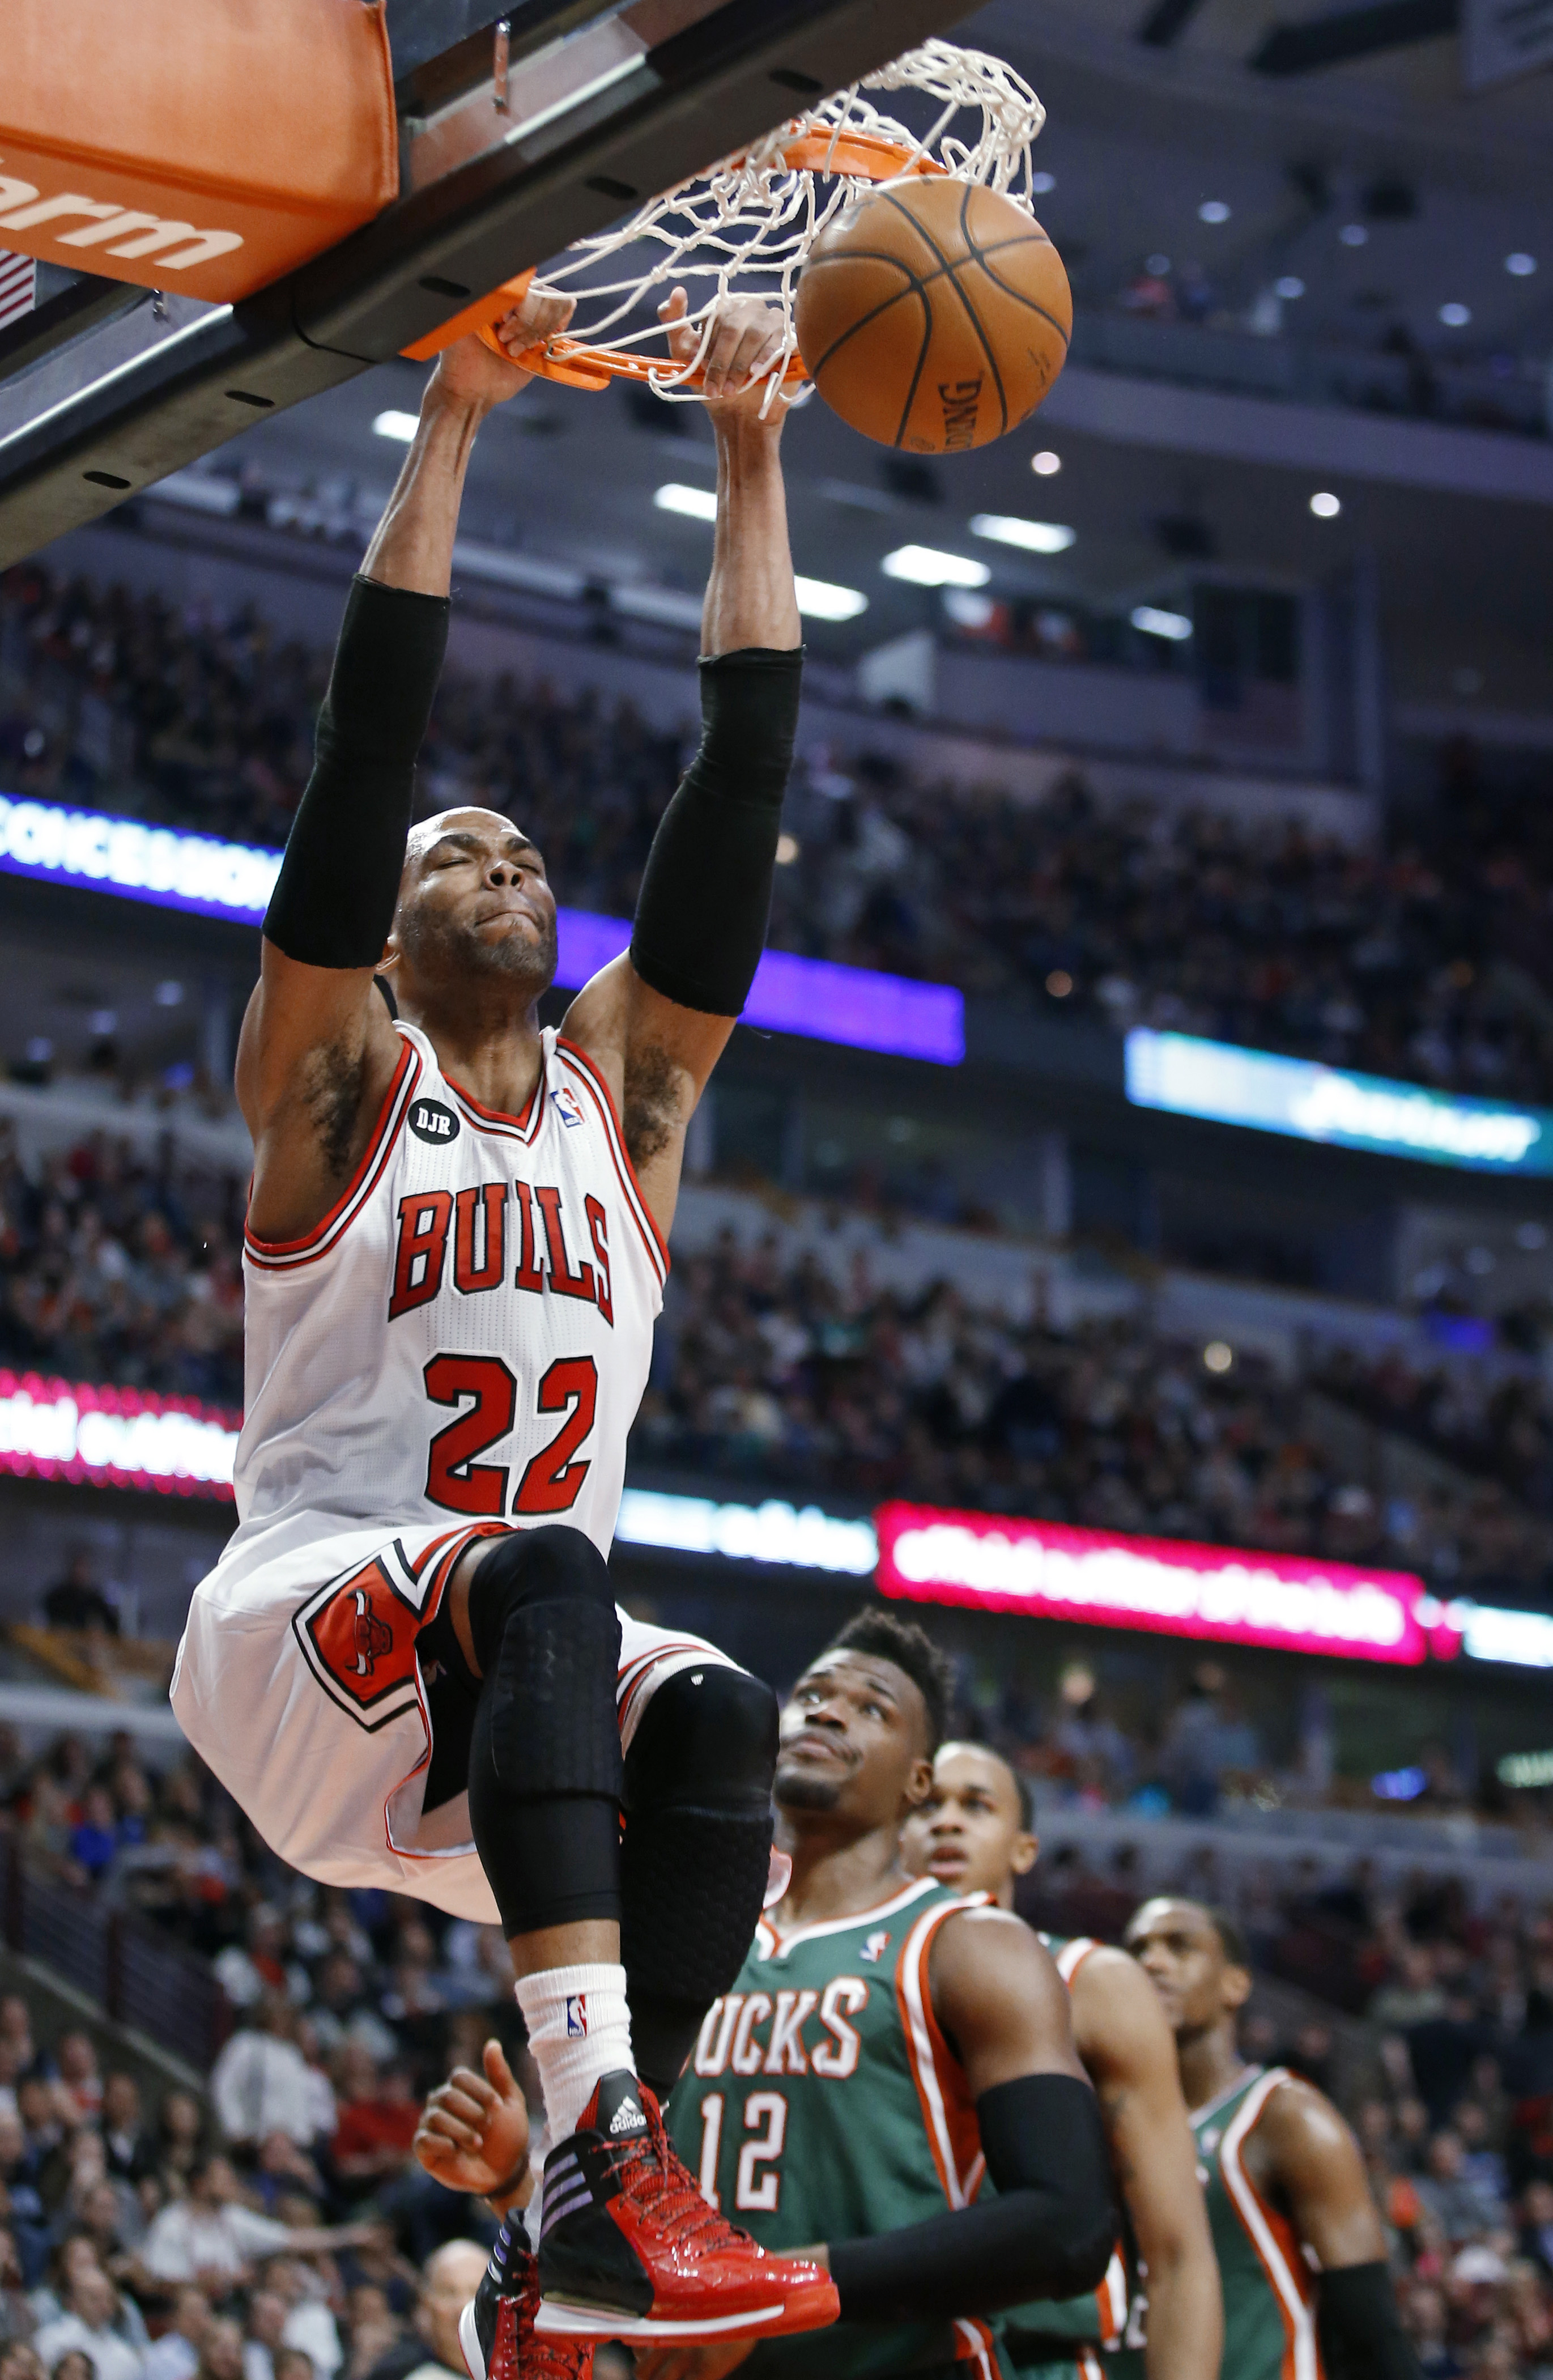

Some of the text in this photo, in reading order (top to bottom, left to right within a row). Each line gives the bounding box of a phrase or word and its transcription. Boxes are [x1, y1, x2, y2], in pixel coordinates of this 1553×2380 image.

[416, 1107, 451, 1136] DJR
[388, 1179, 614, 1329] BULLS
[423, 1353, 598, 1518] 22
[679, 1975, 870, 2080] UCKS
[610, 2114, 647, 2135] adida
[700, 2091, 789, 2212] 12
